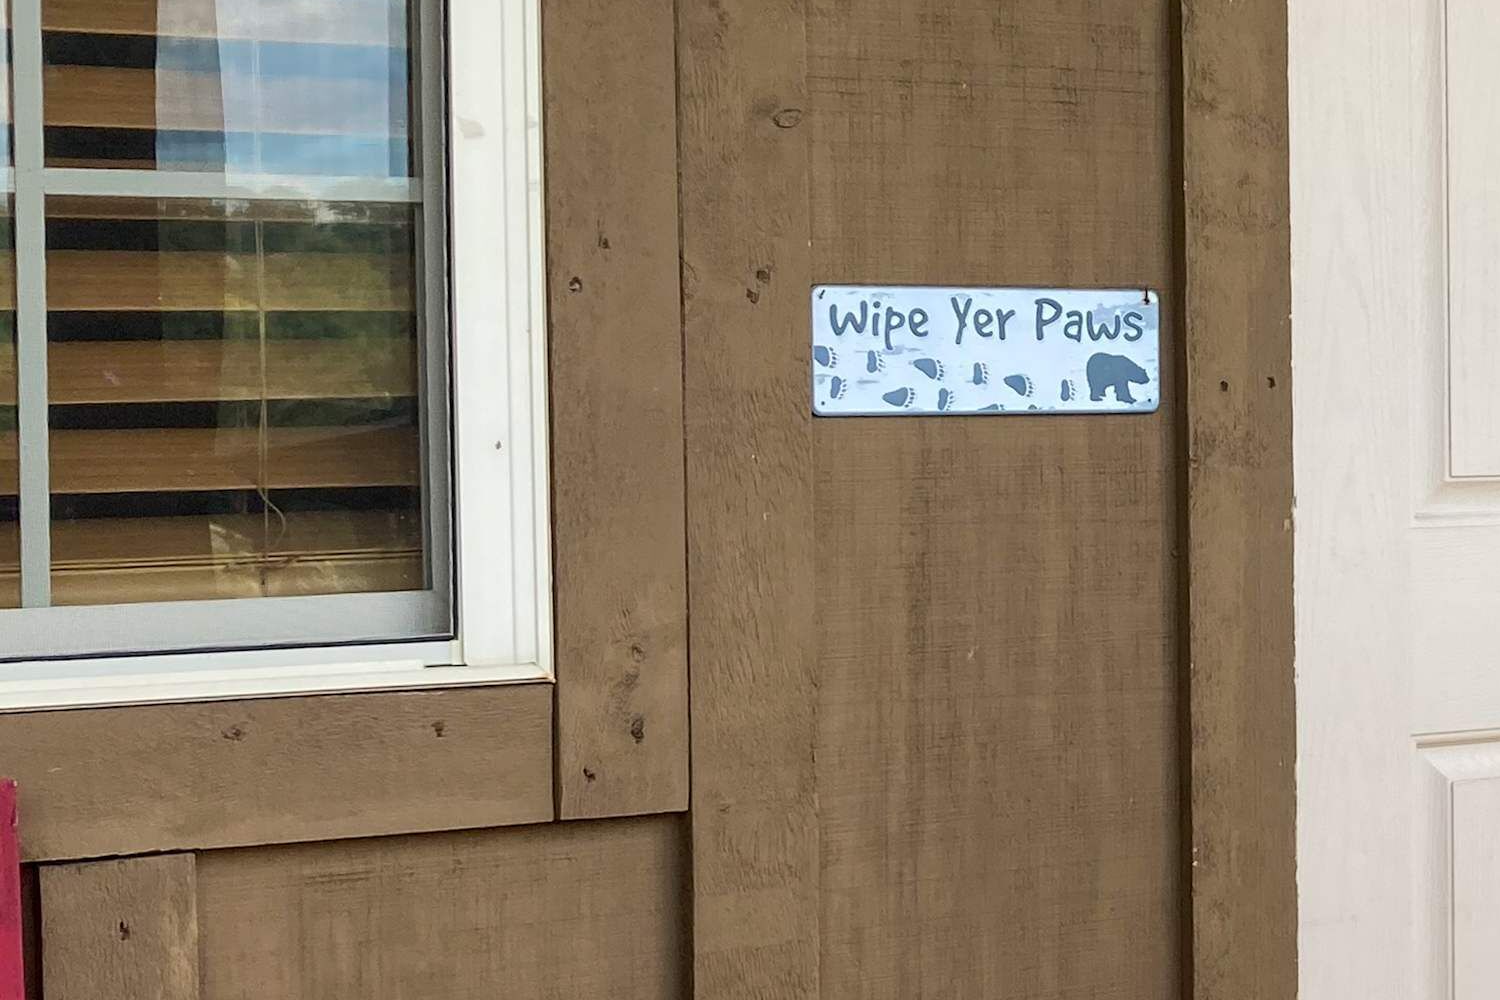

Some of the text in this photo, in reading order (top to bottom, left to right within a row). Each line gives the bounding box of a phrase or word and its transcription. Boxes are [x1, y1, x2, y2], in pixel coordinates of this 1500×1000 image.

[829, 297, 1144, 350] Wipe Yer Paws
